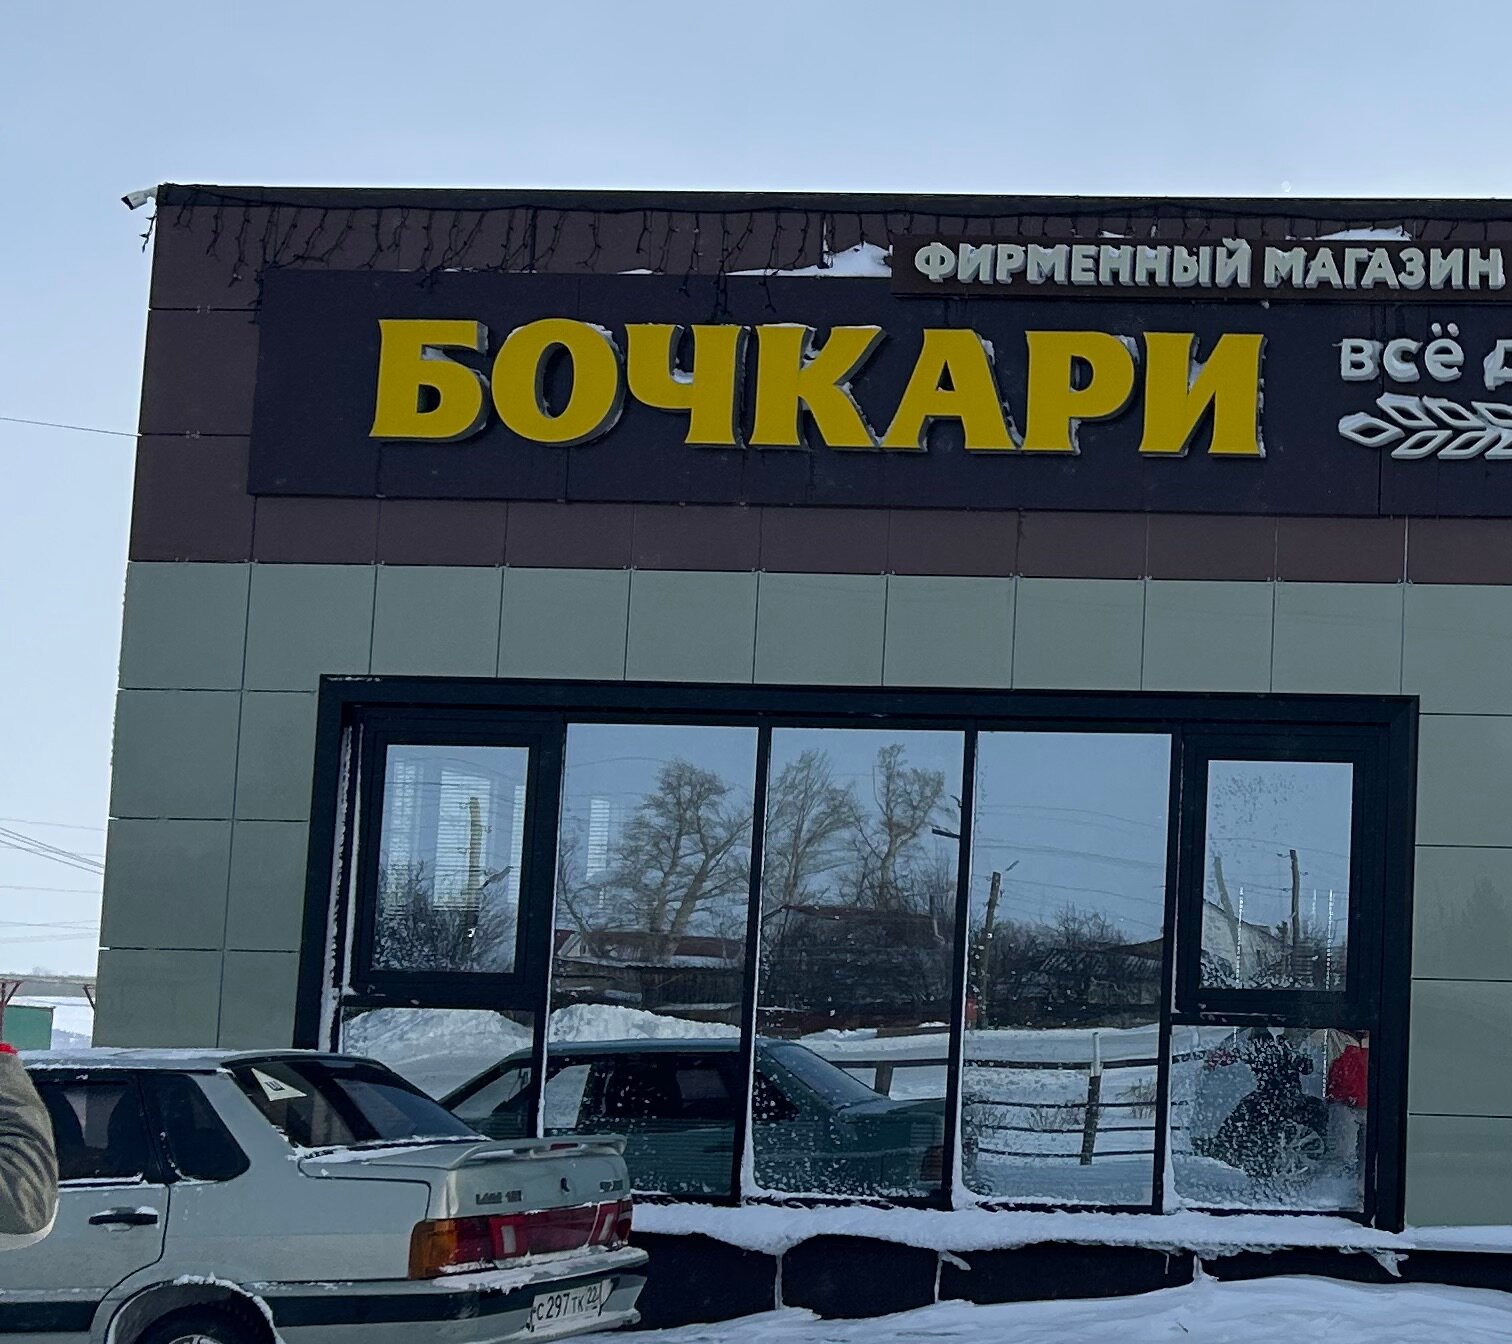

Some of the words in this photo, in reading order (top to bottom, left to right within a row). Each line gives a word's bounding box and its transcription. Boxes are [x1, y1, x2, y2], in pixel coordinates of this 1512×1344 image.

[914, 238, 1252, 289] ФИРМЕННЫЙ
[1264, 246, 1505, 291] МАГАЗИН
[1339, 323, 1464, 383] всё
[370, 317, 1267, 459] БОЧКАРИ
